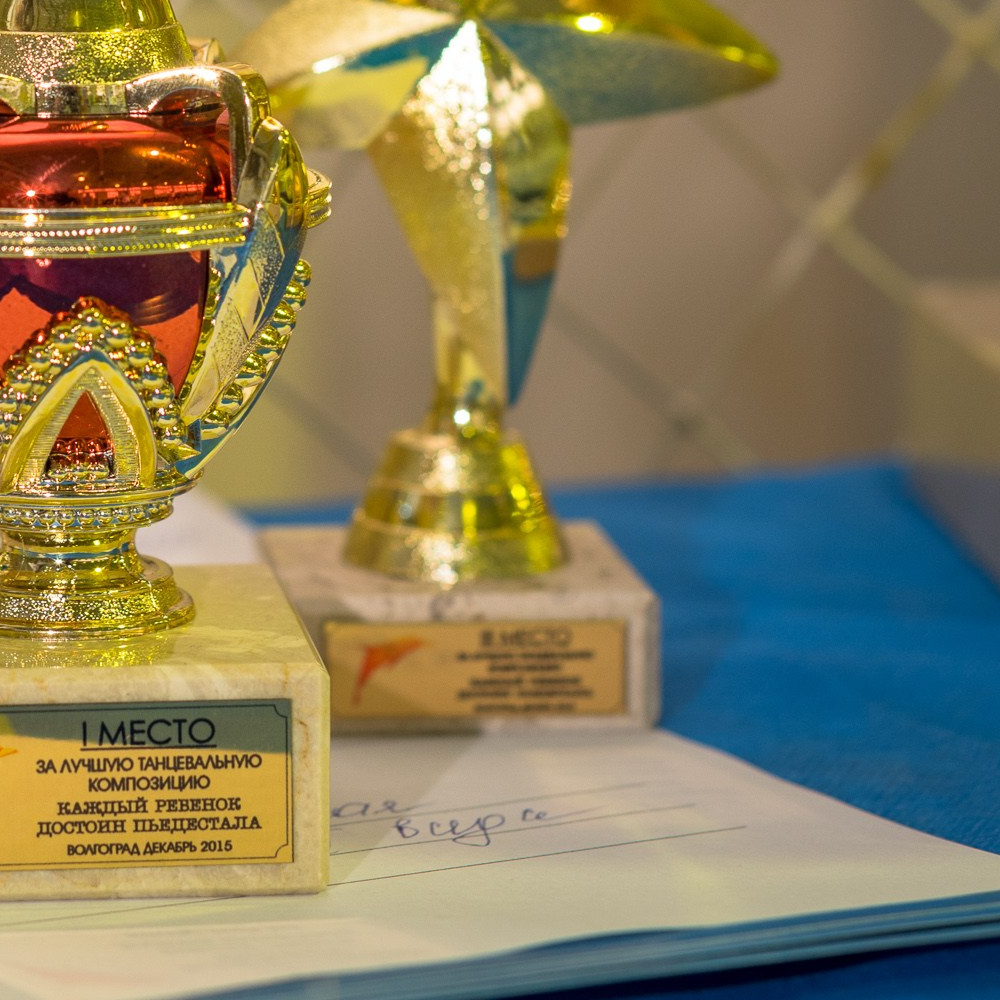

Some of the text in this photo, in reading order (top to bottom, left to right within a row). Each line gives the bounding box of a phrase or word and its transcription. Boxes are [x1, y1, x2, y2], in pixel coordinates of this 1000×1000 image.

[99, 718, 215, 746] МЕСТО
[36, 754, 262, 774] ЗА ЛУЧШУЮ ТАНЦЕВАЛЬНУЮ
[89, 775, 211, 792] КОМПОЗИЦИЮ
[57, 797, 148, 816] КАЖДЫЙ
[36, 816, 262, 837] ДОСТОИН ПЬЕДЕСТАЛА
[67, 840, 232, 856] ВОЛГОГРАД ДЕКАБРЬ 2015
